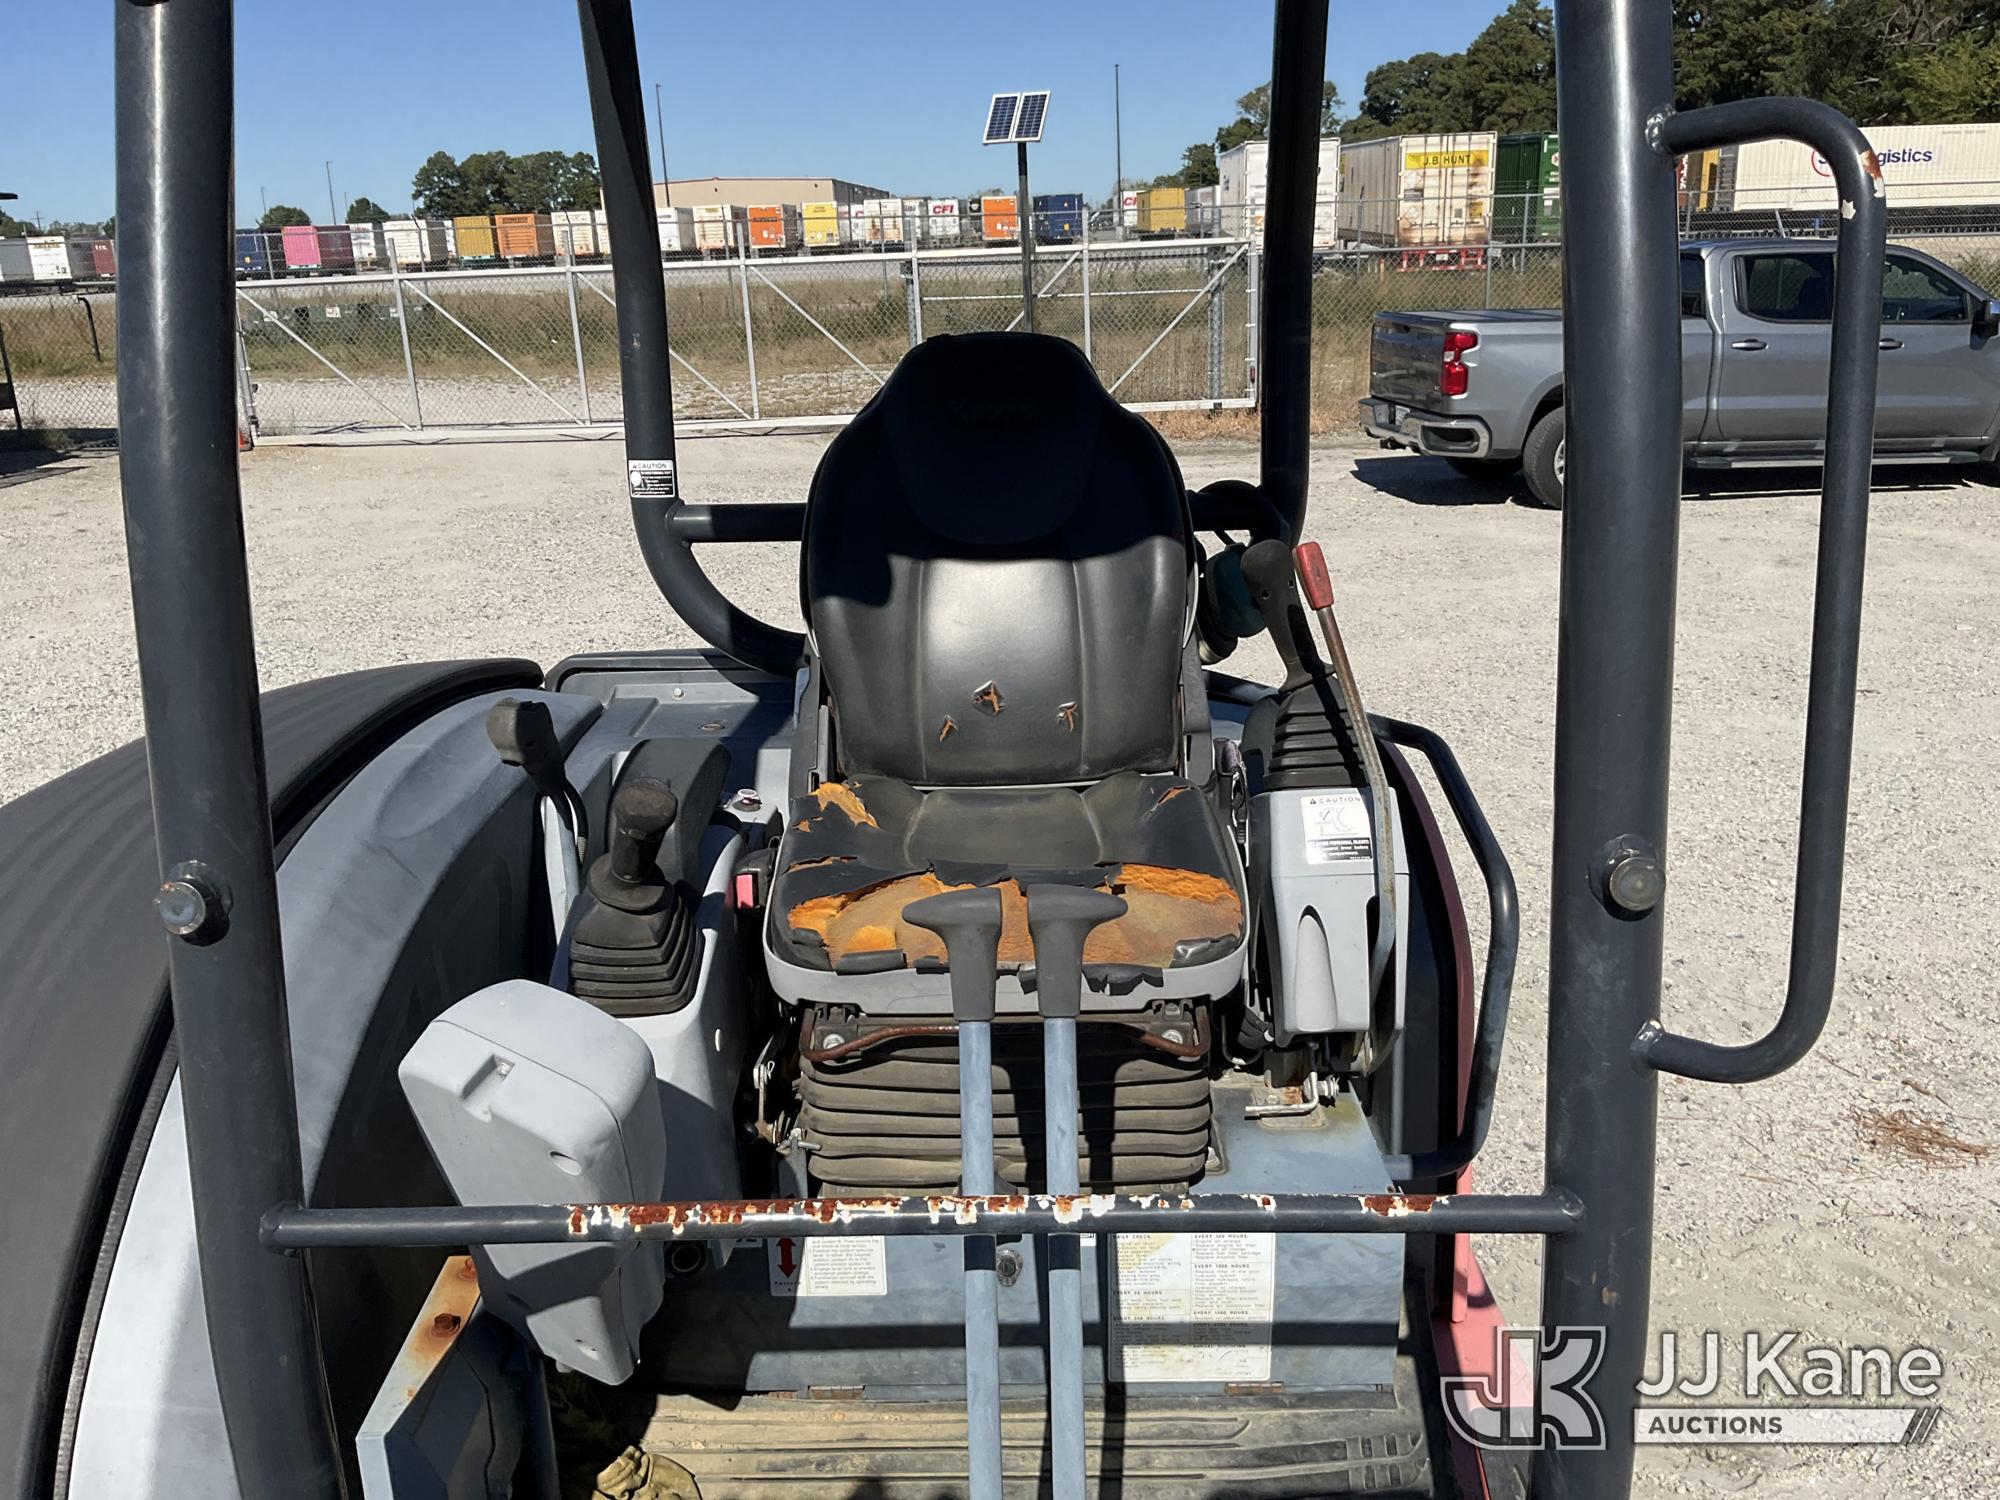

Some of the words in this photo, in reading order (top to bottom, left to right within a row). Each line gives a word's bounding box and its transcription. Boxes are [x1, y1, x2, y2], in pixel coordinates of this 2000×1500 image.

[1443, 154, 1471, 165] HUNT
[1877, 148, 1933, 167] gistics
[932, 204, 954, 214] CFI
[1319, 796, 1360, 804] CAUTION
